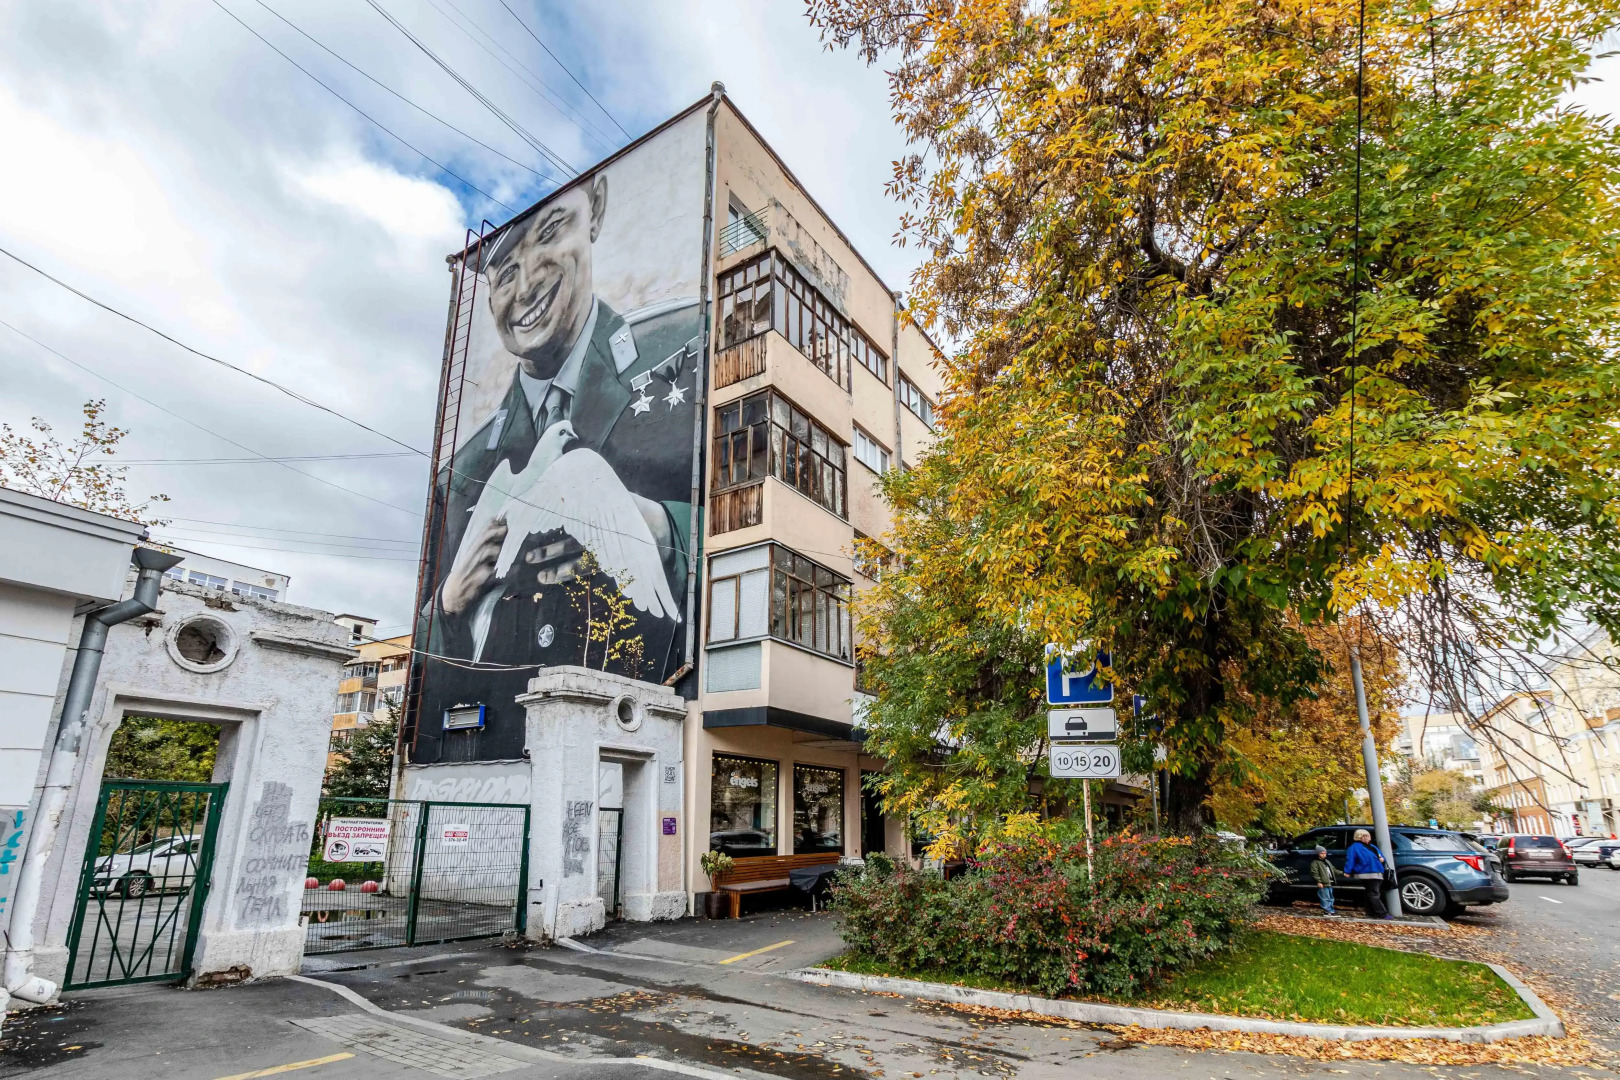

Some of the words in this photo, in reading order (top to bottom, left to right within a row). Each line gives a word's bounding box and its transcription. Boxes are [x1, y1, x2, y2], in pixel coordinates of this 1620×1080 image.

[1057, 757, 1069, 766] 10
[1073, 756, 1087, 767] 15
[1093, 755, 1111, 768] 20
[334, 825, 386, 833] ПОСТОРОННИМ
